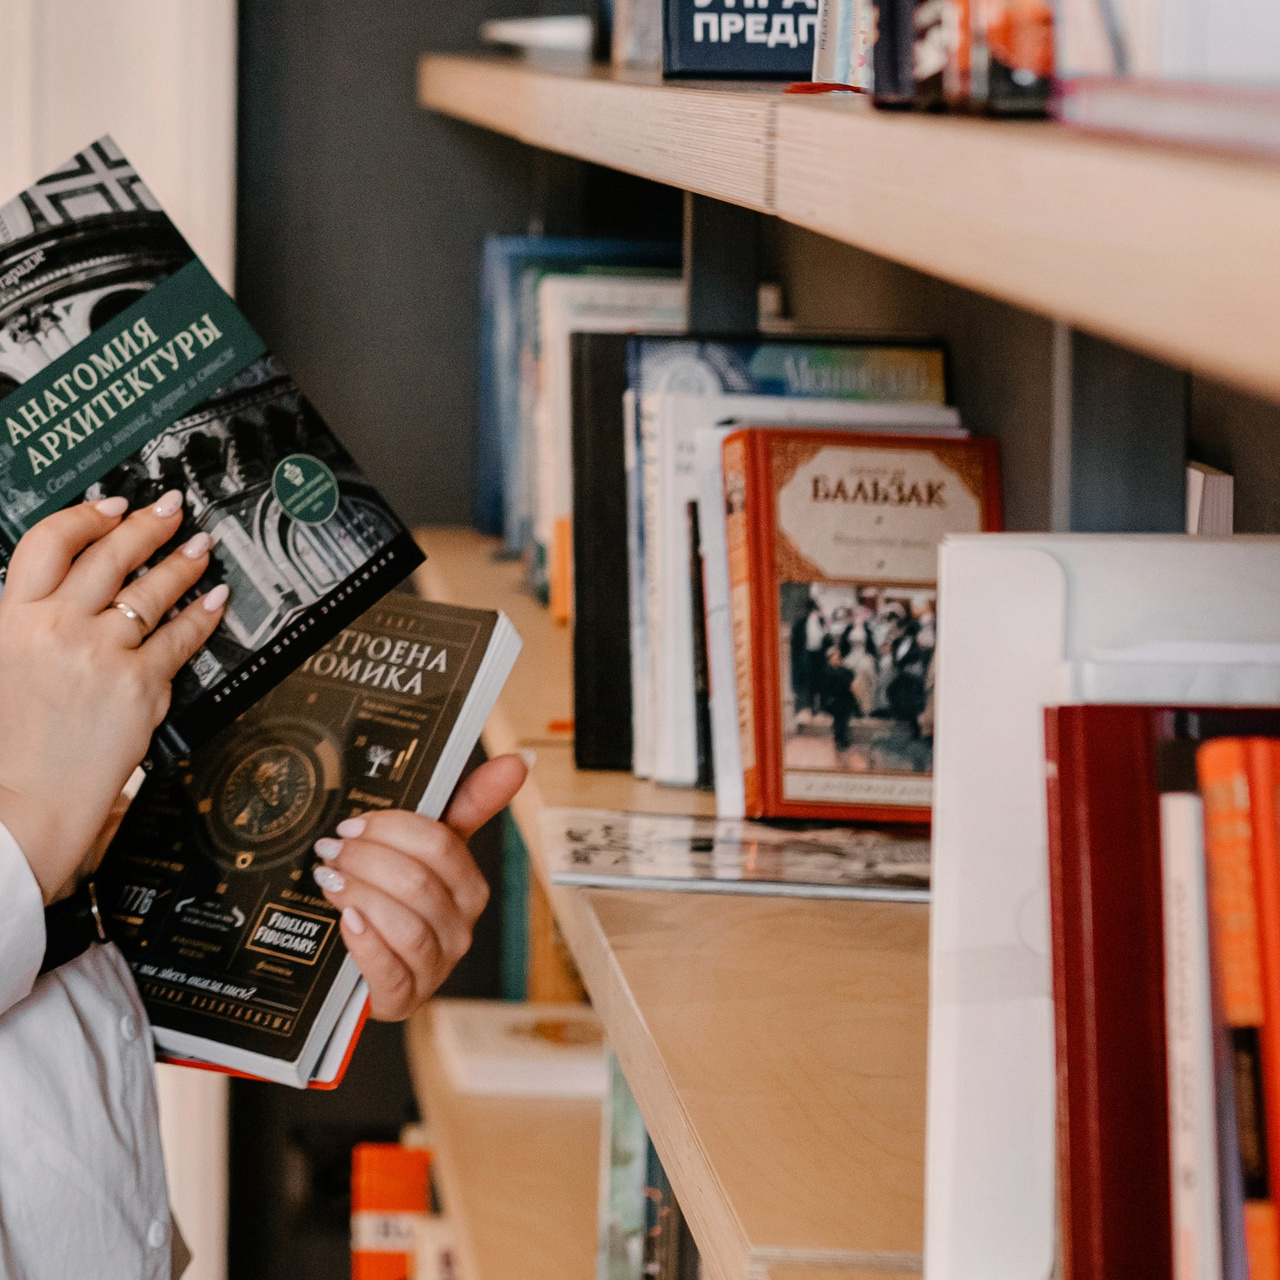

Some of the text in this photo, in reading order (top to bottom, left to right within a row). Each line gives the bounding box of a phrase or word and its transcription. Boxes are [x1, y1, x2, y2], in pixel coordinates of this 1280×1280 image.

[693, 12, 820, 48] ПРЕДП
[7, 315, 159, 446] АНАТОМИЯ
[29, 312, 224, 475] АРХИТЕКТУРЫ
[811, 472, 949, 509] БАЛЬЗАК
[324, 628, 446, 673] ТРОЕНА
[267, 911, 321, 937] FIDELITY
